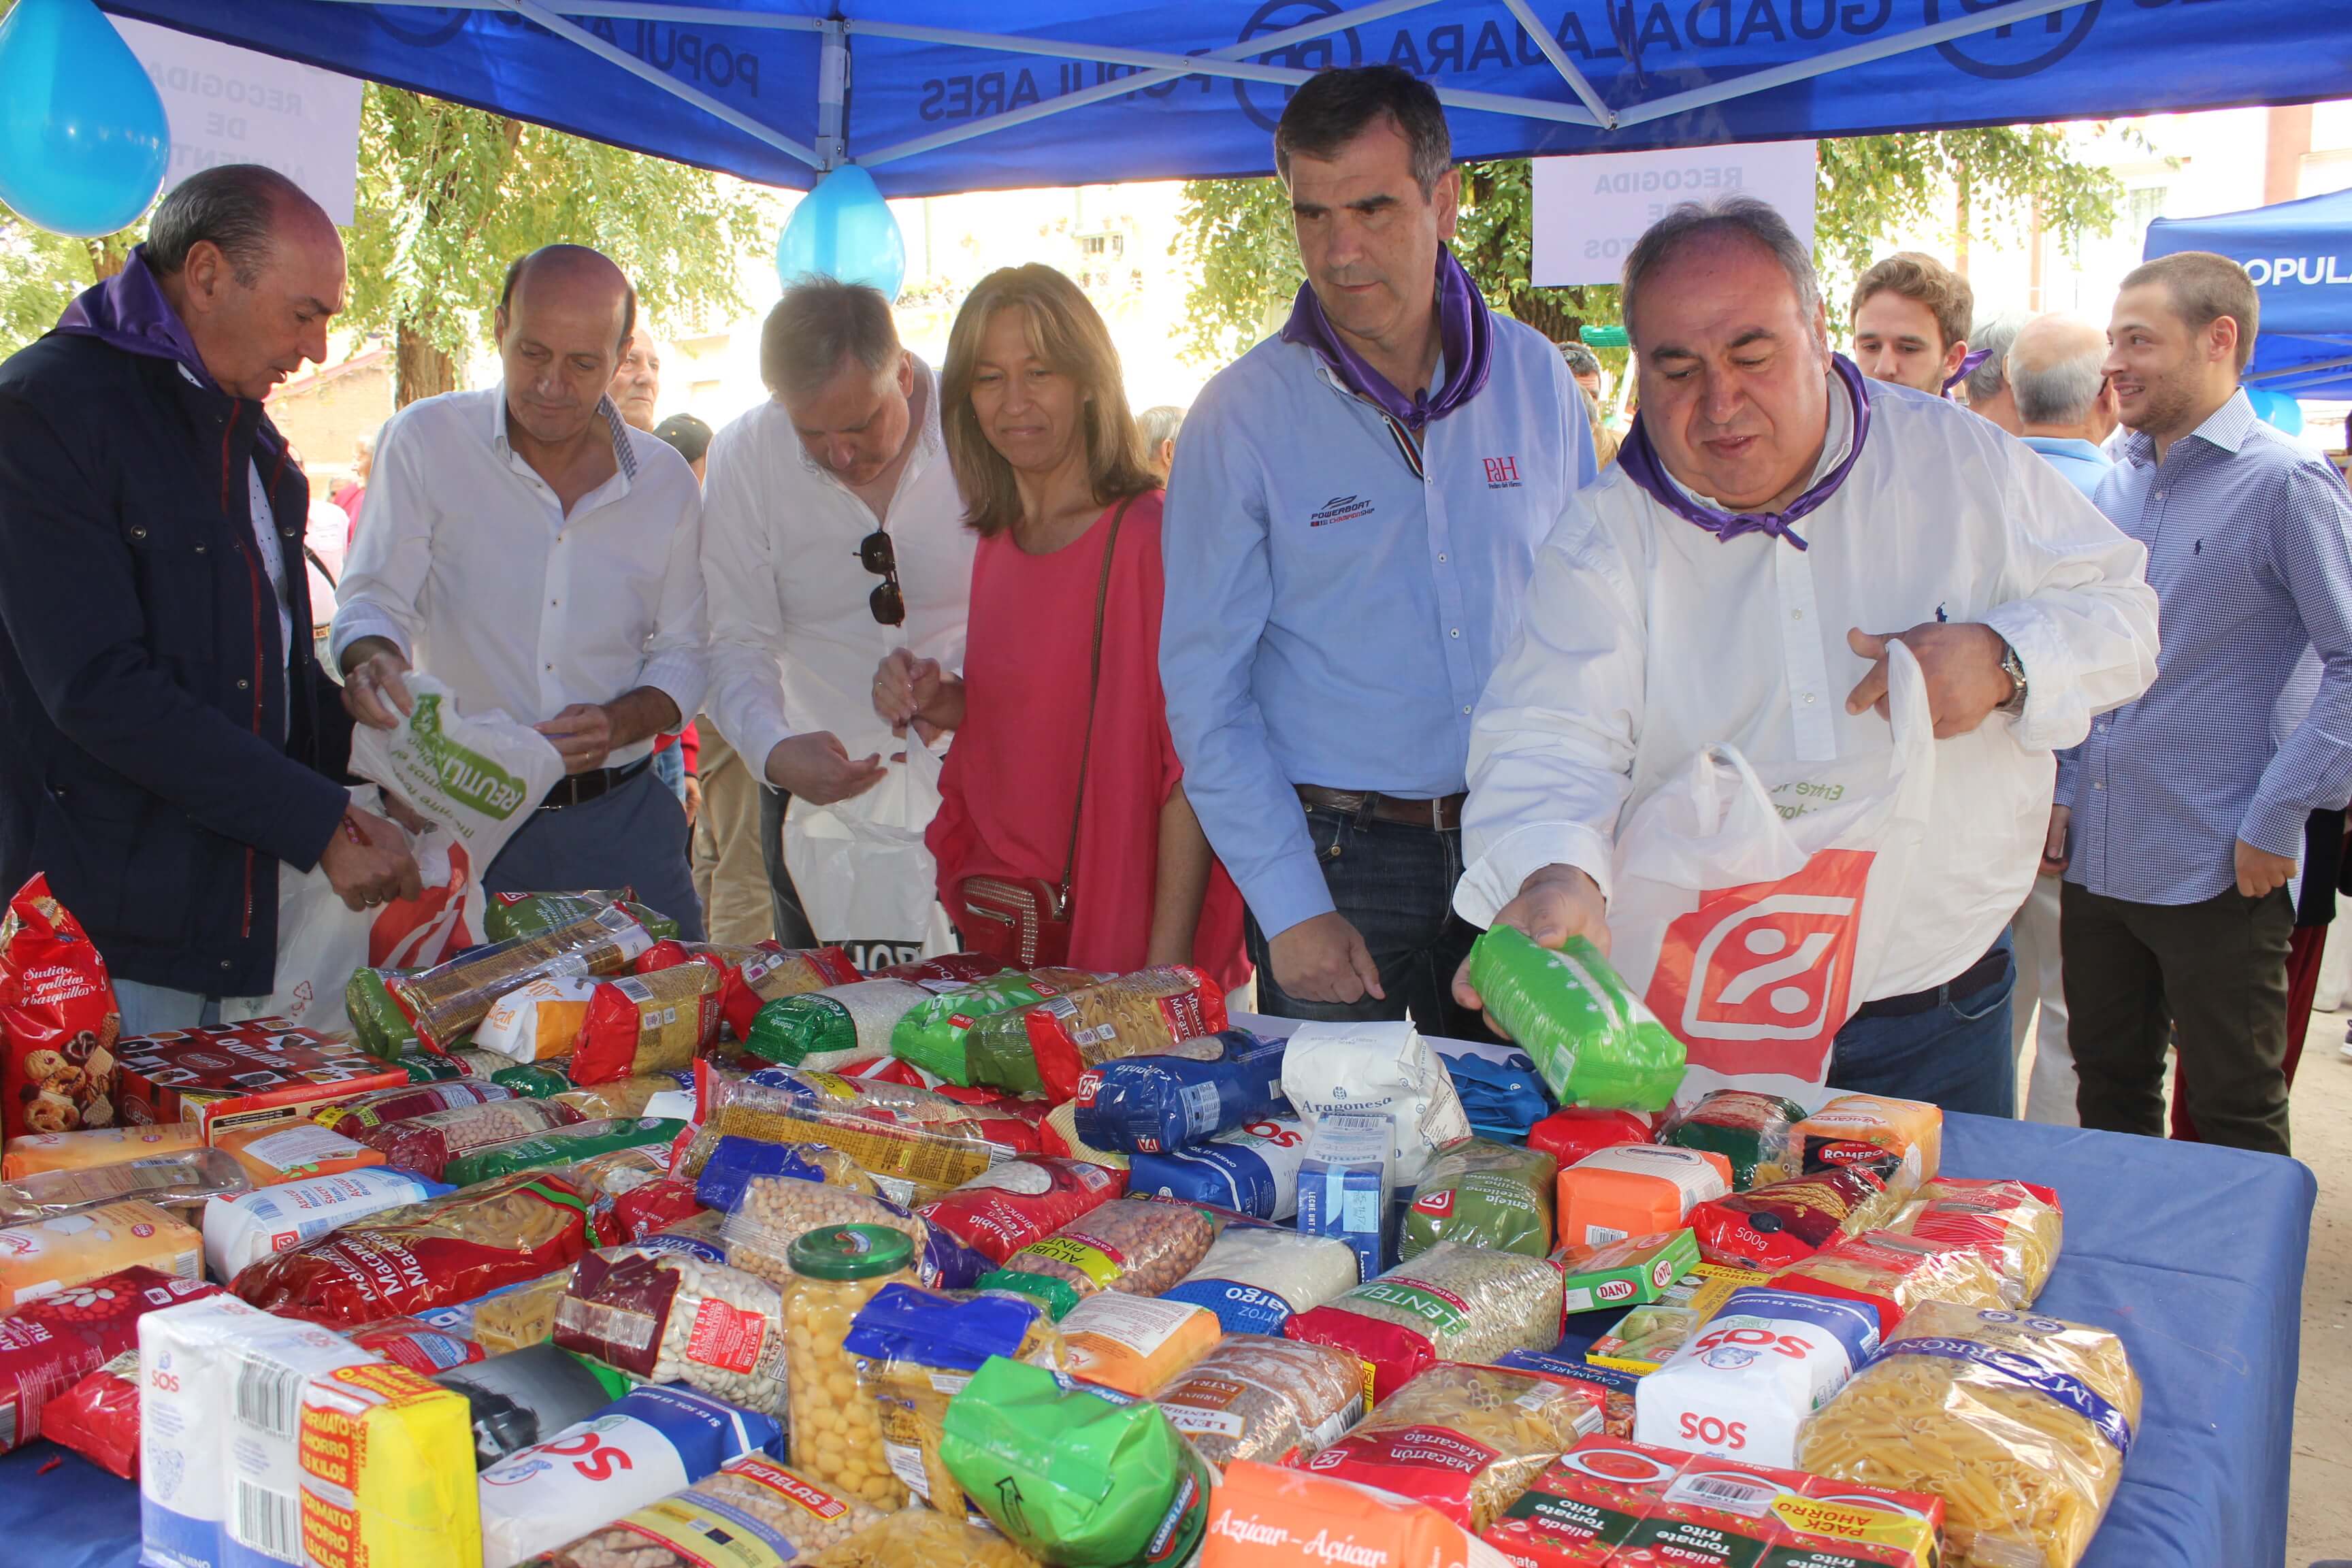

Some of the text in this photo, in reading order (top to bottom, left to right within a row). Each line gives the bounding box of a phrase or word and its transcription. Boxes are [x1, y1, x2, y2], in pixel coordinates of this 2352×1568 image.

[2232, 256, 2352, 287] OPUL
[1311, 500, 1371, 520] POWERBOAT
[31, 986, 89, 1006] barquillos
[37, 975, 84, 996] galletas
[1301, 1096, 1392, 1114] Aragonesa
[1242, 1122, 1303, 1148] SO
[1213, 1150, 1237, 1168] BUENO
[1824, 1149, 1884, 1160] ROMERO
[1308, 1192, 1316, 1211] LECHE
[969, 1214, 1011, 1242] Alubia
[1735, 1226, 1769, 1252] 500g
[1656, 1262, 1672, 1285] DANI
[1696, 1269, 1762, 1283] AHORRO
[1714, 1266, 1755, 1276] PACK
[1600, 1283, 1629, 1298] DANI
[688, 1300, 710, 1358] ALUBIA
[1688, 1328, 1815, 1360] SOS
[1541, 1362, 1621, 1386] CALAMARES
[1616, 1363, 1625, 1372] de
[152, 1369, 180, 1392] SOS
[1193, 1379, 1239, 1392] EXTRA
[696, 1410, 710, 1419] ES
[708, 1418, 721, 1428] SI
[1679, 1411, 1748, 1450] SOS
[1403, 1431, 1488, 1463] Macarrão
[312, 1456, 346, 1484] KILOS
[1390, 1447, 1476, 1473] Macarrón
[742, 1463, 829, 1506] PENELAS
[1533, 1503, 1606, 1531] Tomate
[1557, 1499, 1601, 1517] frito
[1777, 1502, 1873, 1526] AHORRO
[1150, 1513, 1176, 1554] CAMPO
[1211, 1508, 1388, 1567] Azúcar Açúcar
[1537, 1516, 1596, 1539] aliada
[1680, 1523, 1725, 1542] frito
[1803, 1518, 1864, 1537] PACK
[1656, 1529, 1732, 1557] Tomate
[1660, 1544, 1722, 1565] aliada
